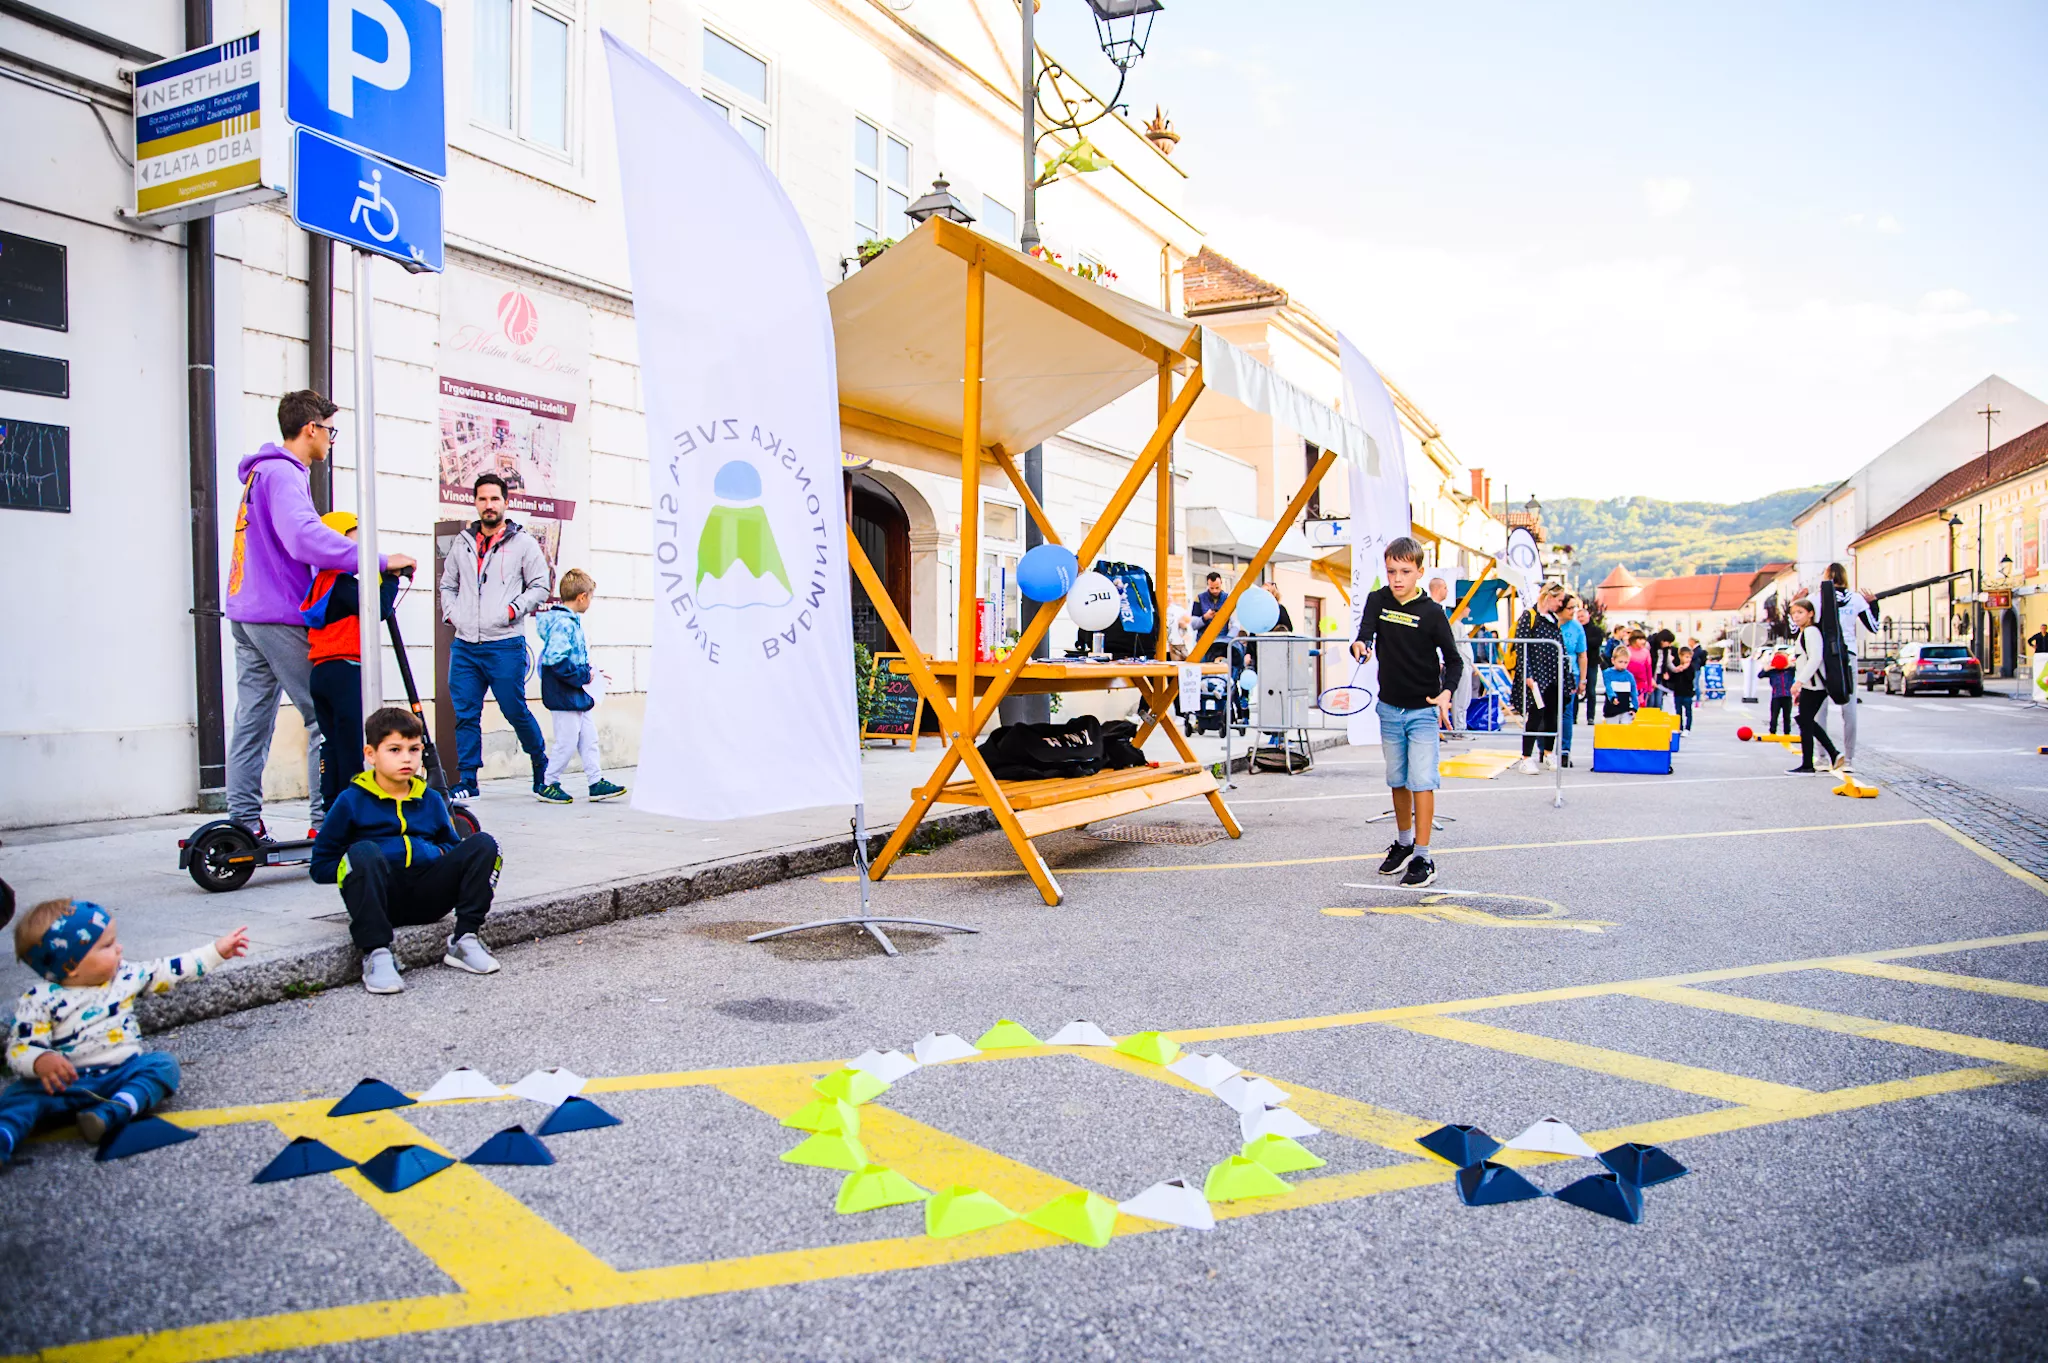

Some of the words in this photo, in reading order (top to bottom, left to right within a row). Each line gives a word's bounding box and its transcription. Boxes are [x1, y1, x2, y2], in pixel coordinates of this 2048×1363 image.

[327, 0, 411, 119] P
[153, 60, 253, 106] NERTHUS
[153, 153, 200, 179] ZLATA
[206, 137, 253, 165] DOBA
[442, 380, 486, 400] Trgovina
[487, 391, 494, 401] z
[495, 391, 538, 410] domačimi
[540, 400, 568, 416] izdelki
[442, 489, 475, 504] Vinote
[508, 497, 537, 512] alnimi
[538, 501, 555, 513] vini
